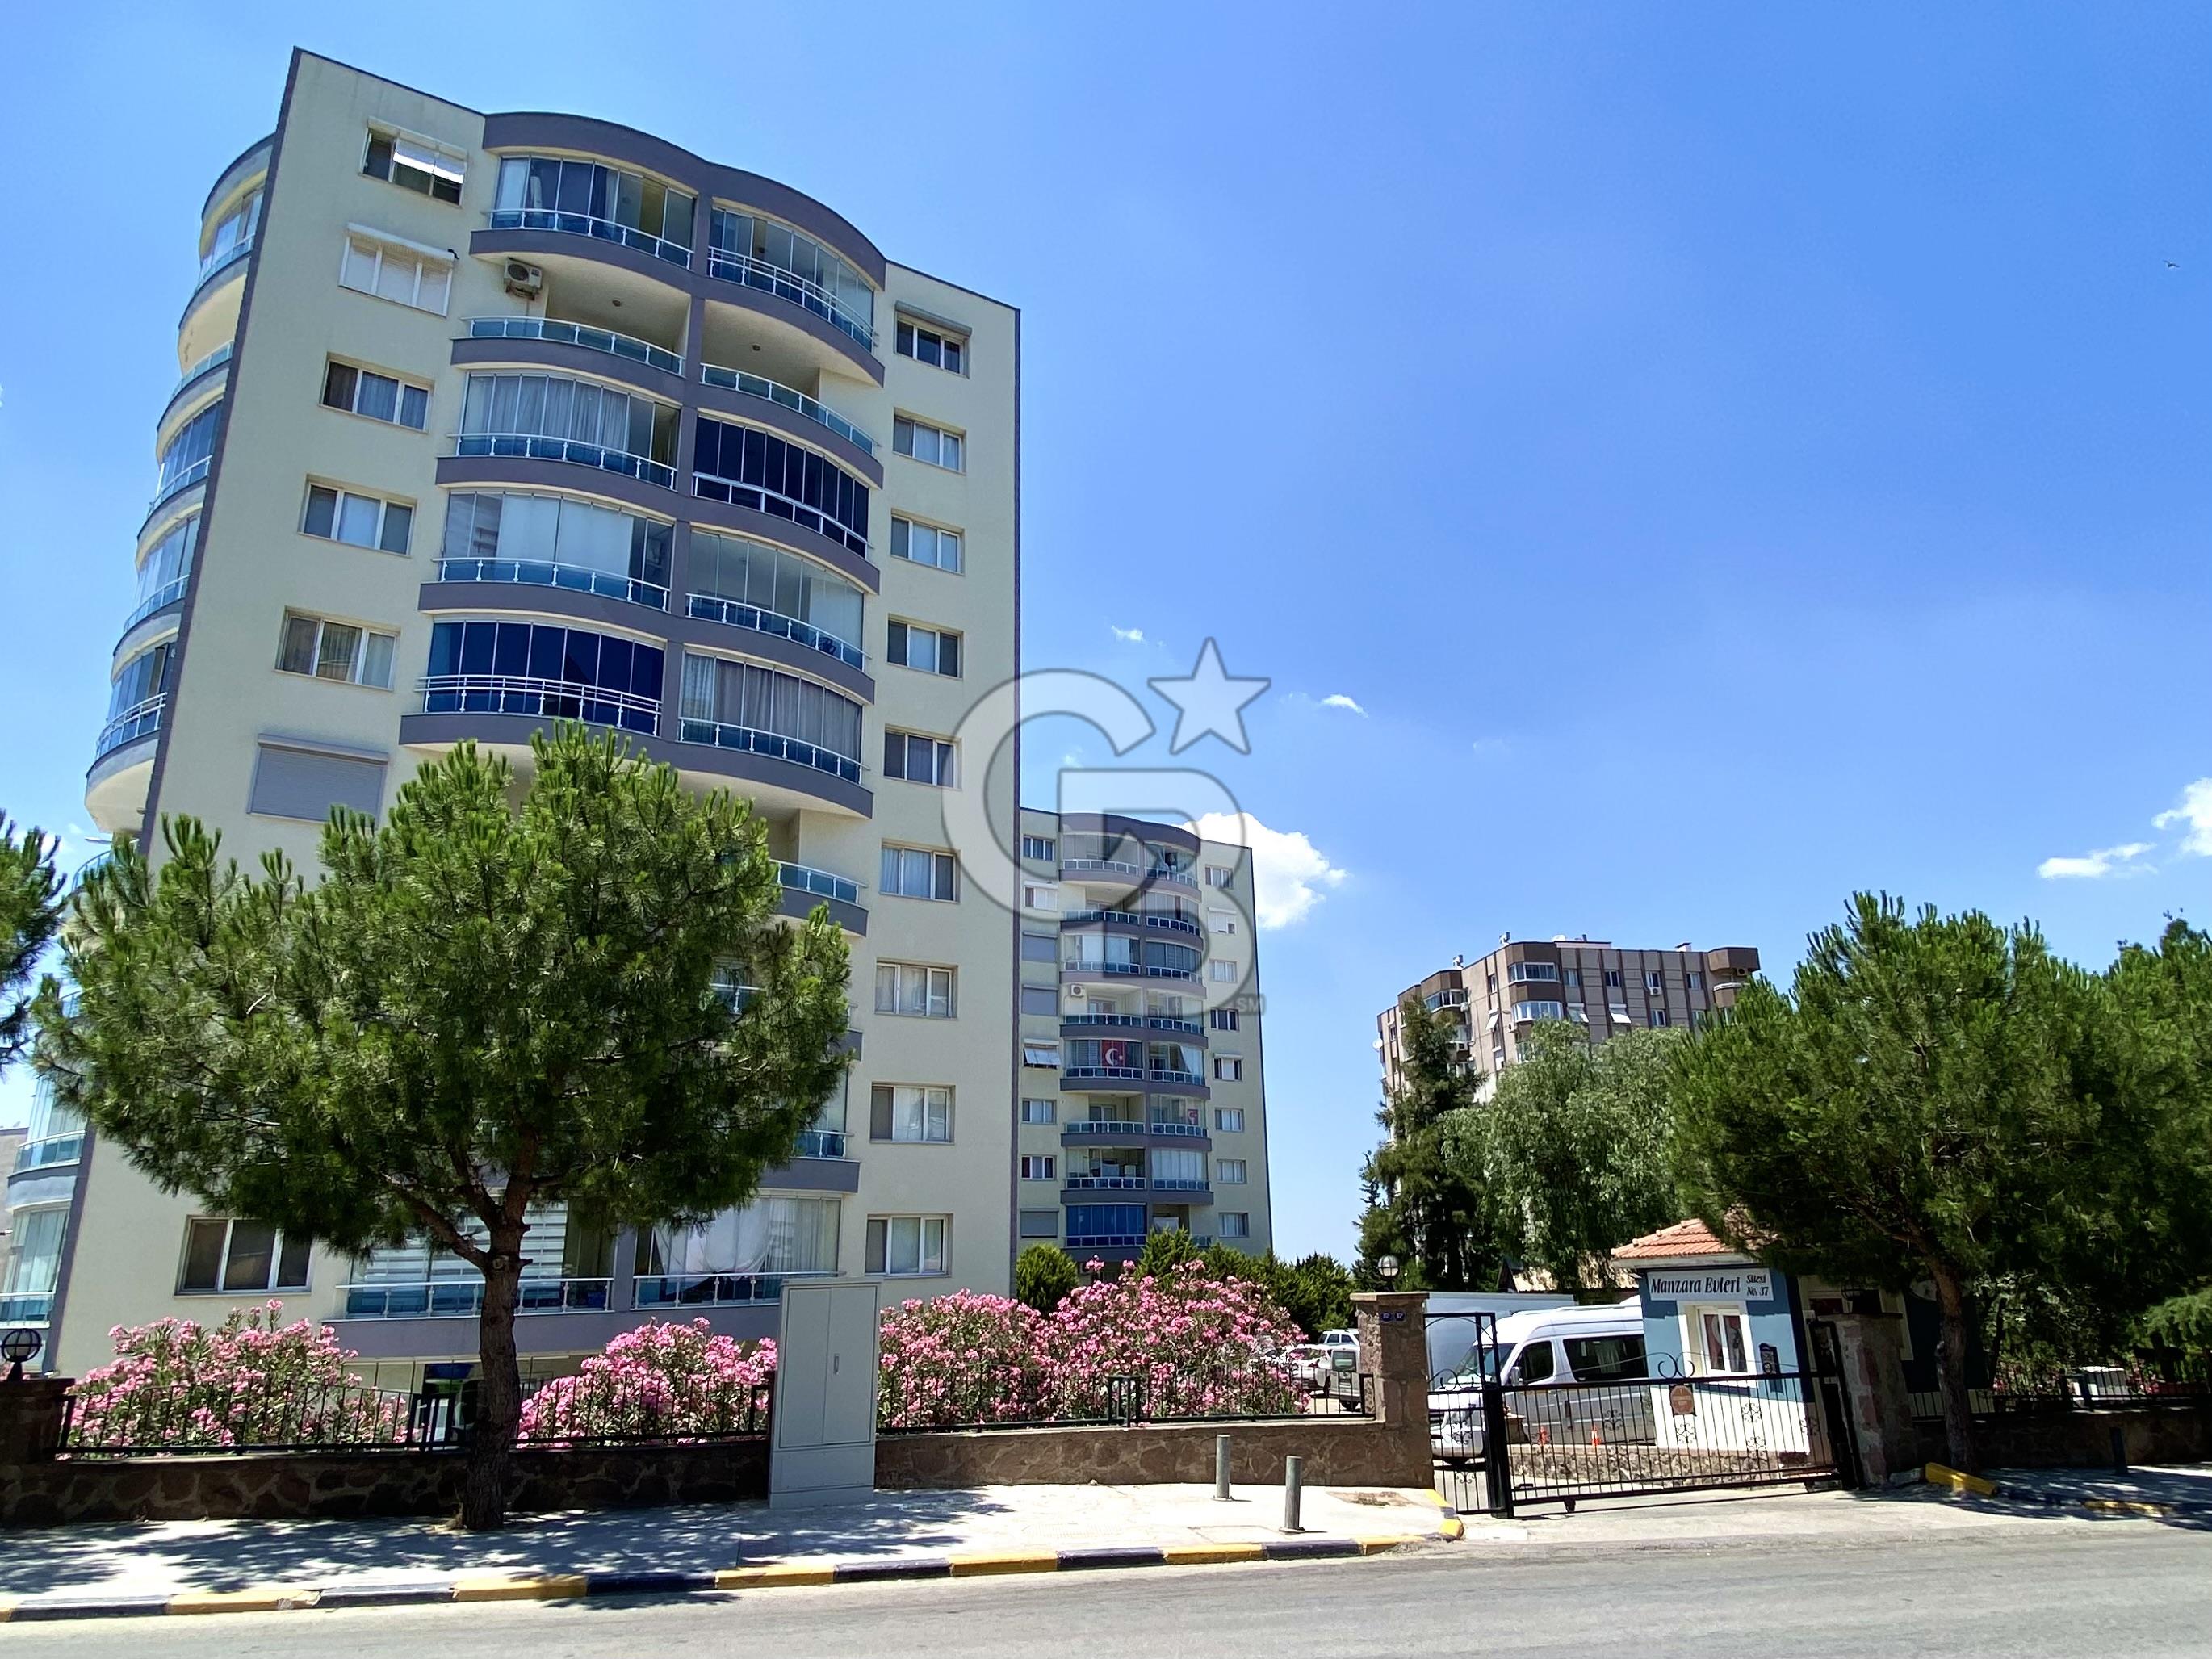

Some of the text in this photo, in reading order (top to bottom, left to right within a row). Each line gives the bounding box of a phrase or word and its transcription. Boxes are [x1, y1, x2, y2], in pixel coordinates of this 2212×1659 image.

[1651, 1276, 1741, 1294] Manzara Evleri
[1759, 1286, 1769, 1297] 37
